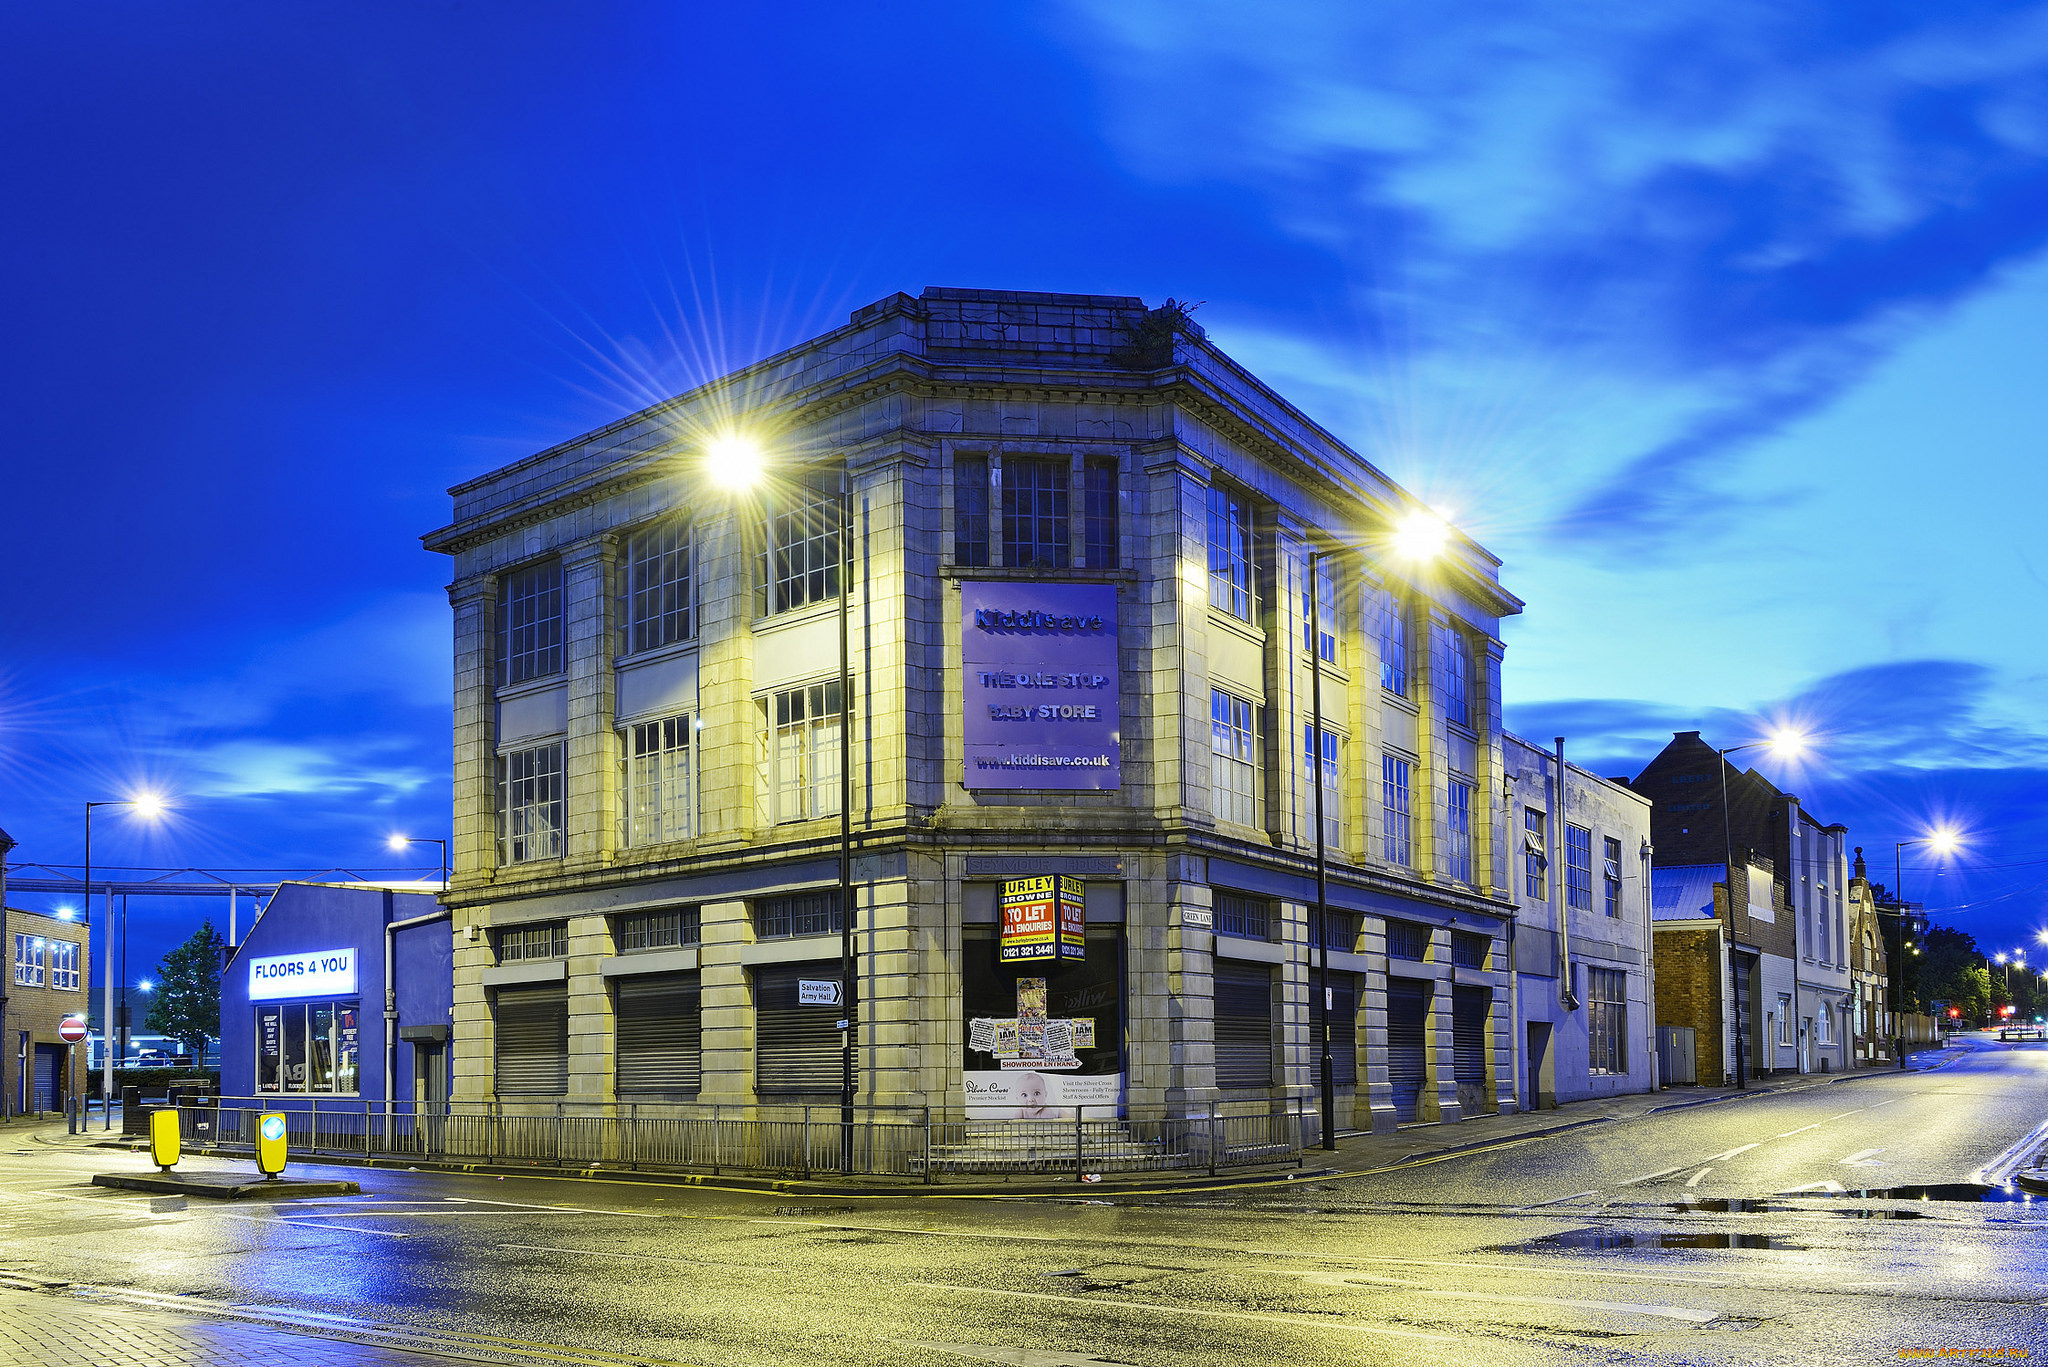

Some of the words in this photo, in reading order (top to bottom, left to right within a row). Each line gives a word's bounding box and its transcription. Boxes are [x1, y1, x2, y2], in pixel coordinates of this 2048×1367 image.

[975, 608, 1103, 630] Kiddisave
[976, 671, 1012, 685] THE
[1016, 671, 1053, 686] ONE
[1058, 672, 1104, 686] STOP
[987, 704, 1033, 718] BABY
[1038, 704, 1096, 718] STORE
[974, 754, 1110, 767] www.kiddisave.co.uk
[969, 858, 1052, 872] SEYMOUR
[1066, 858, 1119, 872] HOUSE
[1000, 876, 1053, 894] BURLEY
[1060, 876, 1083, 894] BURLEY
[1001, 892, 1052, 904] BROWNE
[1060, 892, 1083, 904] BROWNE
[1008, 907, 1022, 923] TO
[1026, 905, 1046, 921] LET
[1064, 906, 1071, 920] TO
[1072, 907, 1081, 922] LET
[1184, 912, 1199, 921] GREEN
[1200, 914, 1212, 923] LANE
[1003, 924, 1015, 934] ALL
[1016, 920, 1052, 933] ENQUIRIES
[1003, 948, 1019, 957] 0121
[1020, 946, 1034, 956] 321
[1036, 944, 1053, 954] 3441
[255, 962, 304, 978] FLOORS
[308, 961, 316, 974] 4
[321, 956, 347, 973] YOU
[801, 984, 831, 992] Salvation
[801, 993, 817, 1001] Army
[819, 993, 831, 1001] Hall
[999, 1030, 1016, 1038] JAM
[966, 1080, 987, 1093] Silver
[989, 1083, 1008, 1093] Cross
